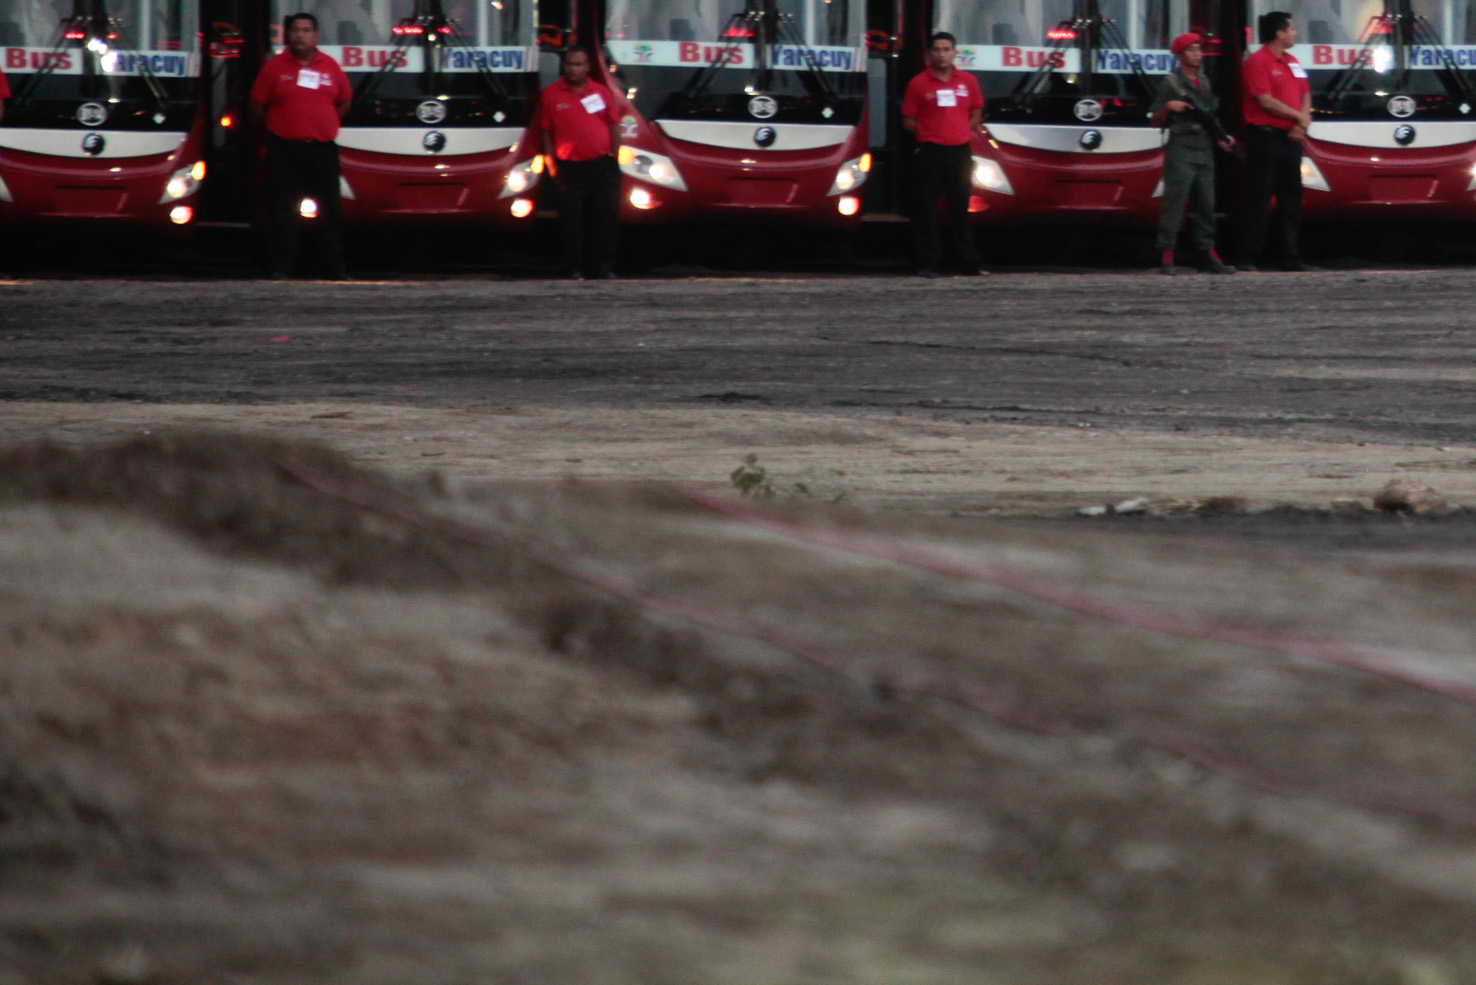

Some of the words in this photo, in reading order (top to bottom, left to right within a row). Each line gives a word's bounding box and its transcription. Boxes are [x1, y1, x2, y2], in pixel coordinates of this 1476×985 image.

[5, 47, 72, 71] Bus
[108, 53, 186, 76] aracuy
[341, 46, 408, 69] Bus
[678, 41, 744, 65] Bus
[772, 45, 853, 70] Yaracuy
[1002, 46, 1066, 69] Bus
[1098, 50, 1178, 74] Yaracuy
